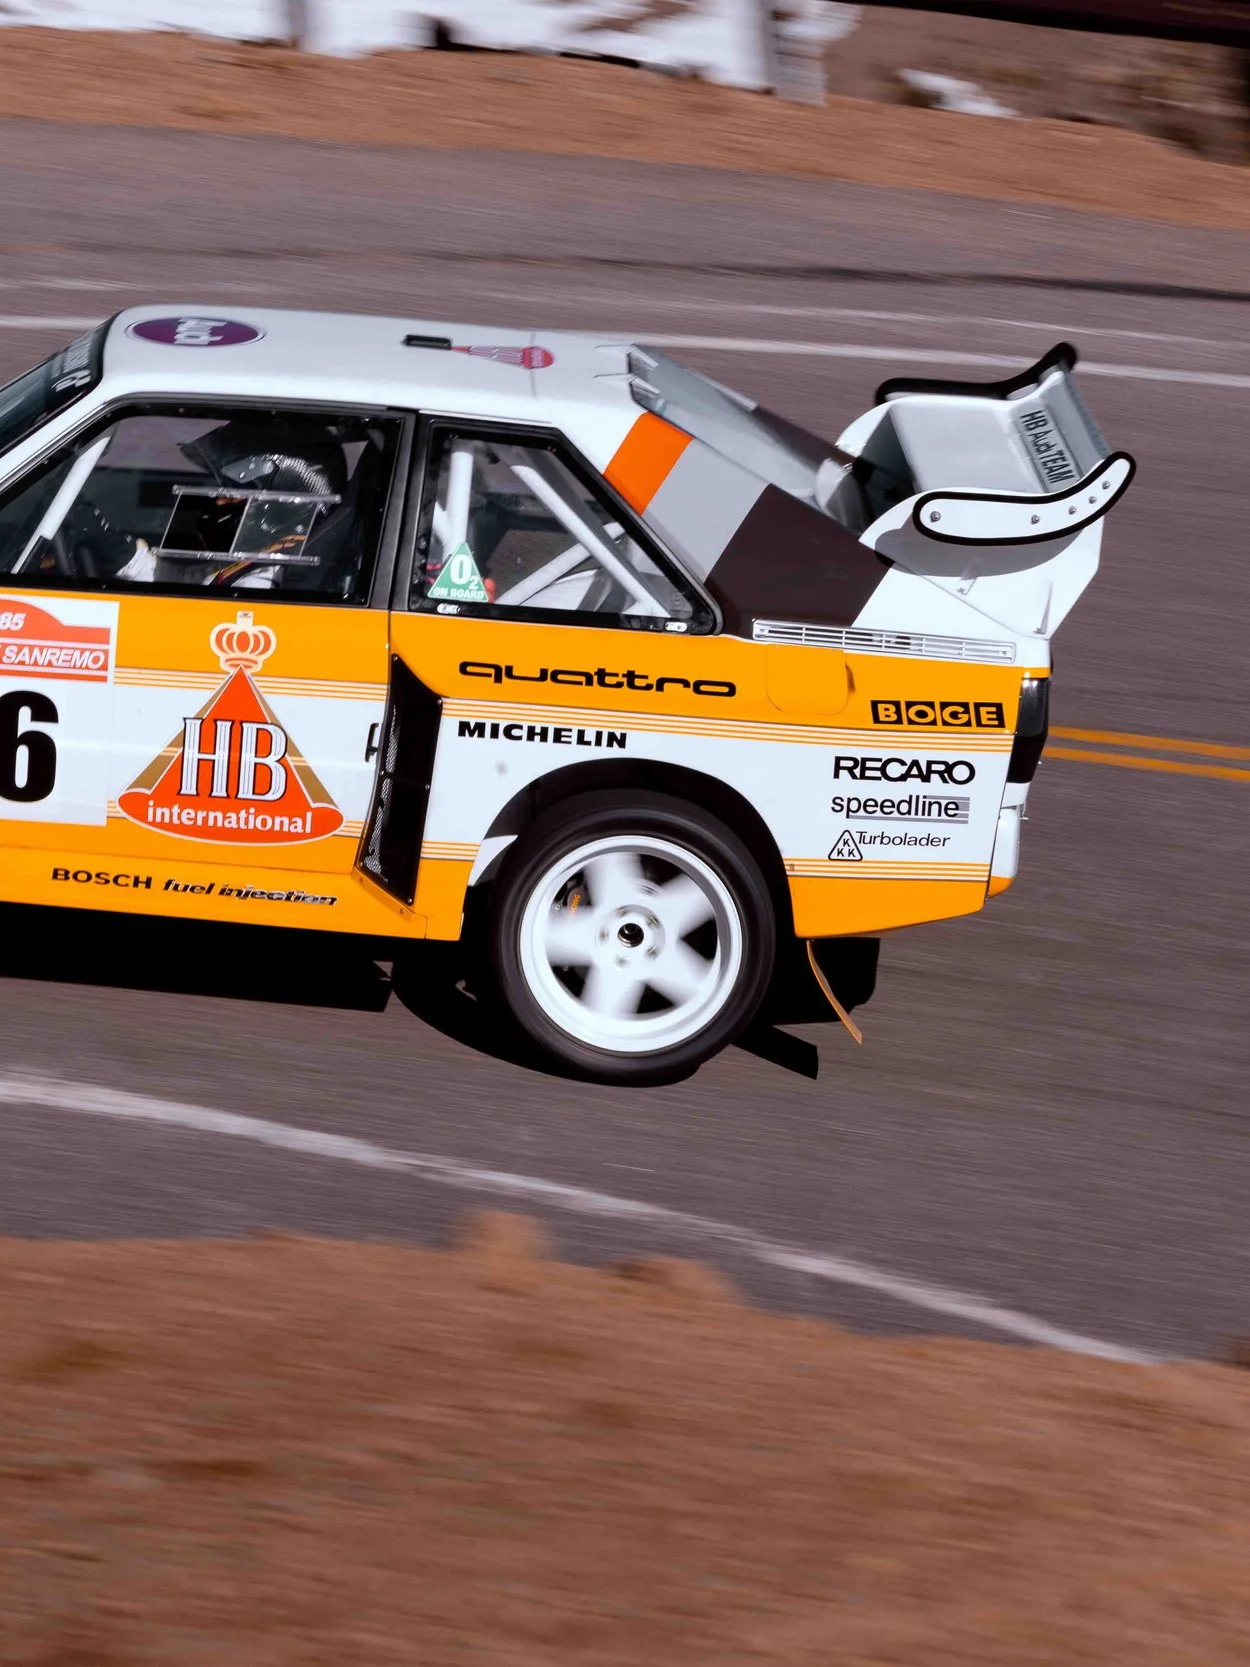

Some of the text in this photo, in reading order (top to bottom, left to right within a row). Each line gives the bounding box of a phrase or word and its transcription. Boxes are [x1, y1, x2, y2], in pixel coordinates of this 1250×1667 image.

[1019, 409, 1048, 431] HB
[1037, 449, 1075, 484] TEAM
[433, 586, 485, 600] ON BOARD
[1, 647, 105, 671] SANREMO
[458, 660, 737, 698] quattro
[876, 703, 1000, 727] BOGE
[457, 720, 628, 749] MICHELIN
[177, 717, 289, 802] HB
[832, 755, 976, 786] RECARO
[147, 800, 312, 834] international
[831, 794, 960, 819] speedline
[855, 831, 951, 848] Turbolader
[51, 867, 338, 907] BOSCH fuel injection
